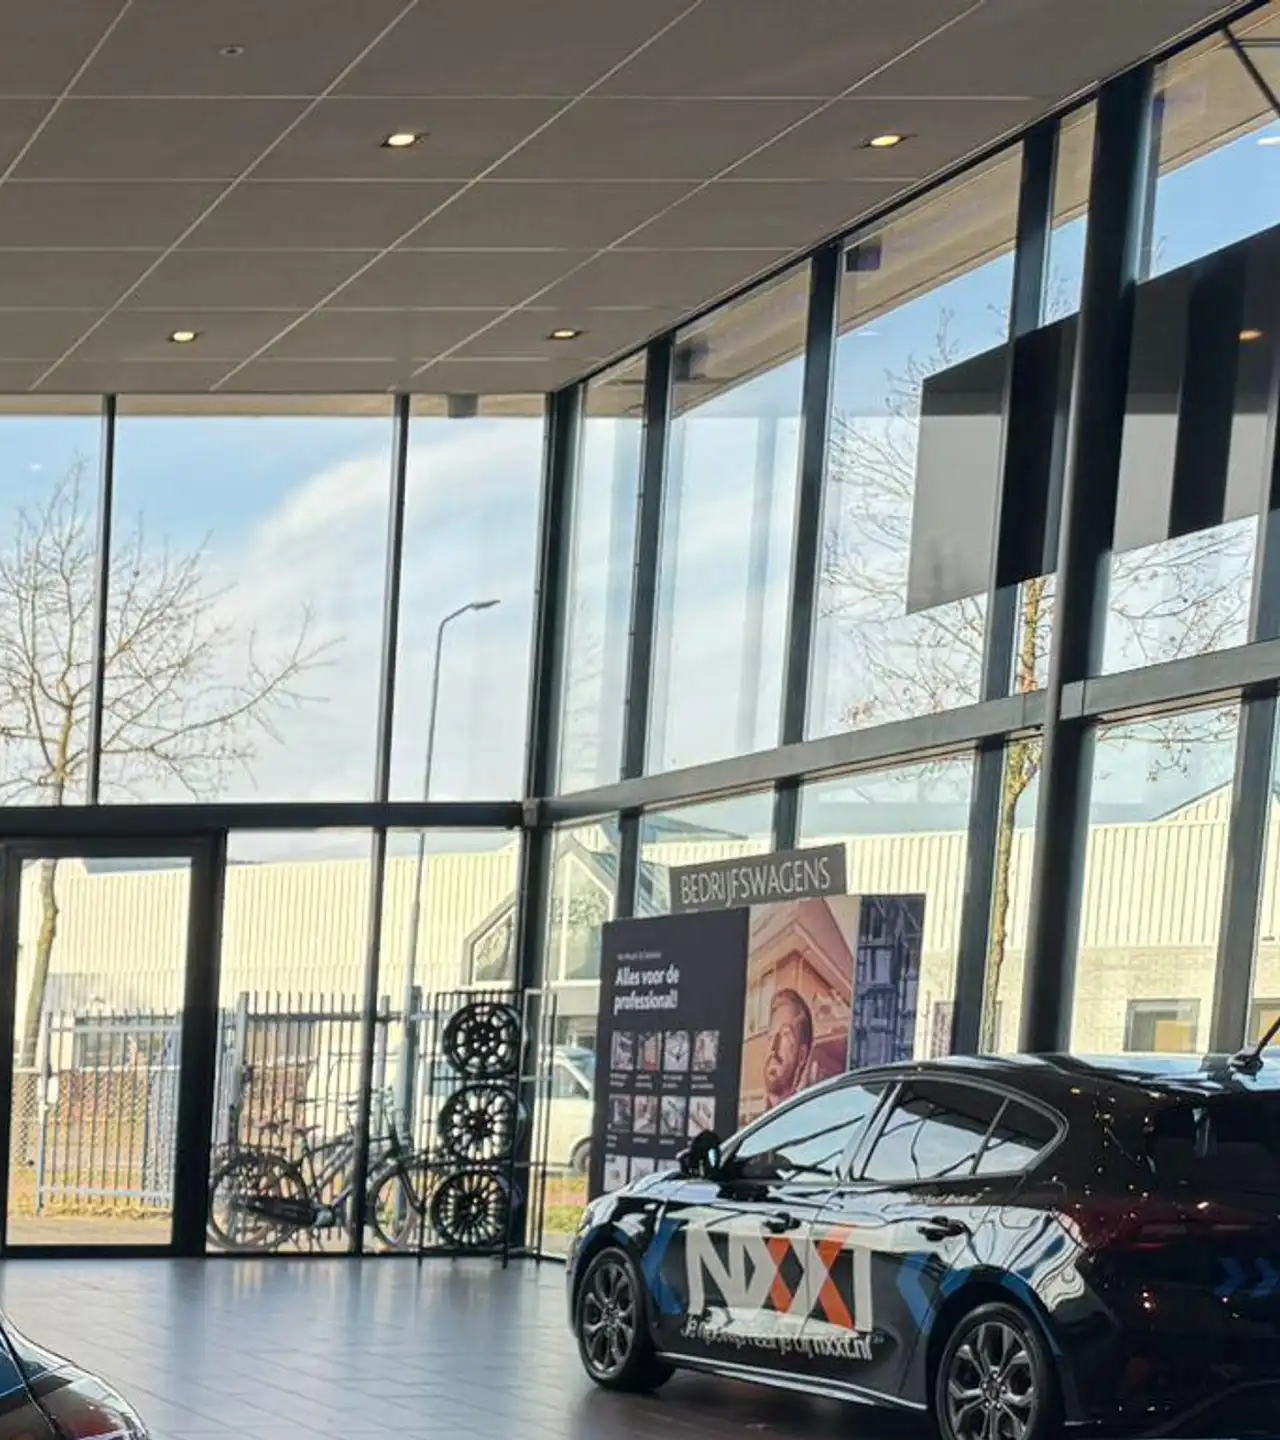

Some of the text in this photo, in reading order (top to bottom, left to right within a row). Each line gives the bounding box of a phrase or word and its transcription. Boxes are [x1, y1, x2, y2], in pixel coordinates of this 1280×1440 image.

[680, 857, 831, 905] BEDRIJFSWAGENS
[614, 962, 680, 986] Alles voor de
[683, 1222, 873, 1332] NXXT
